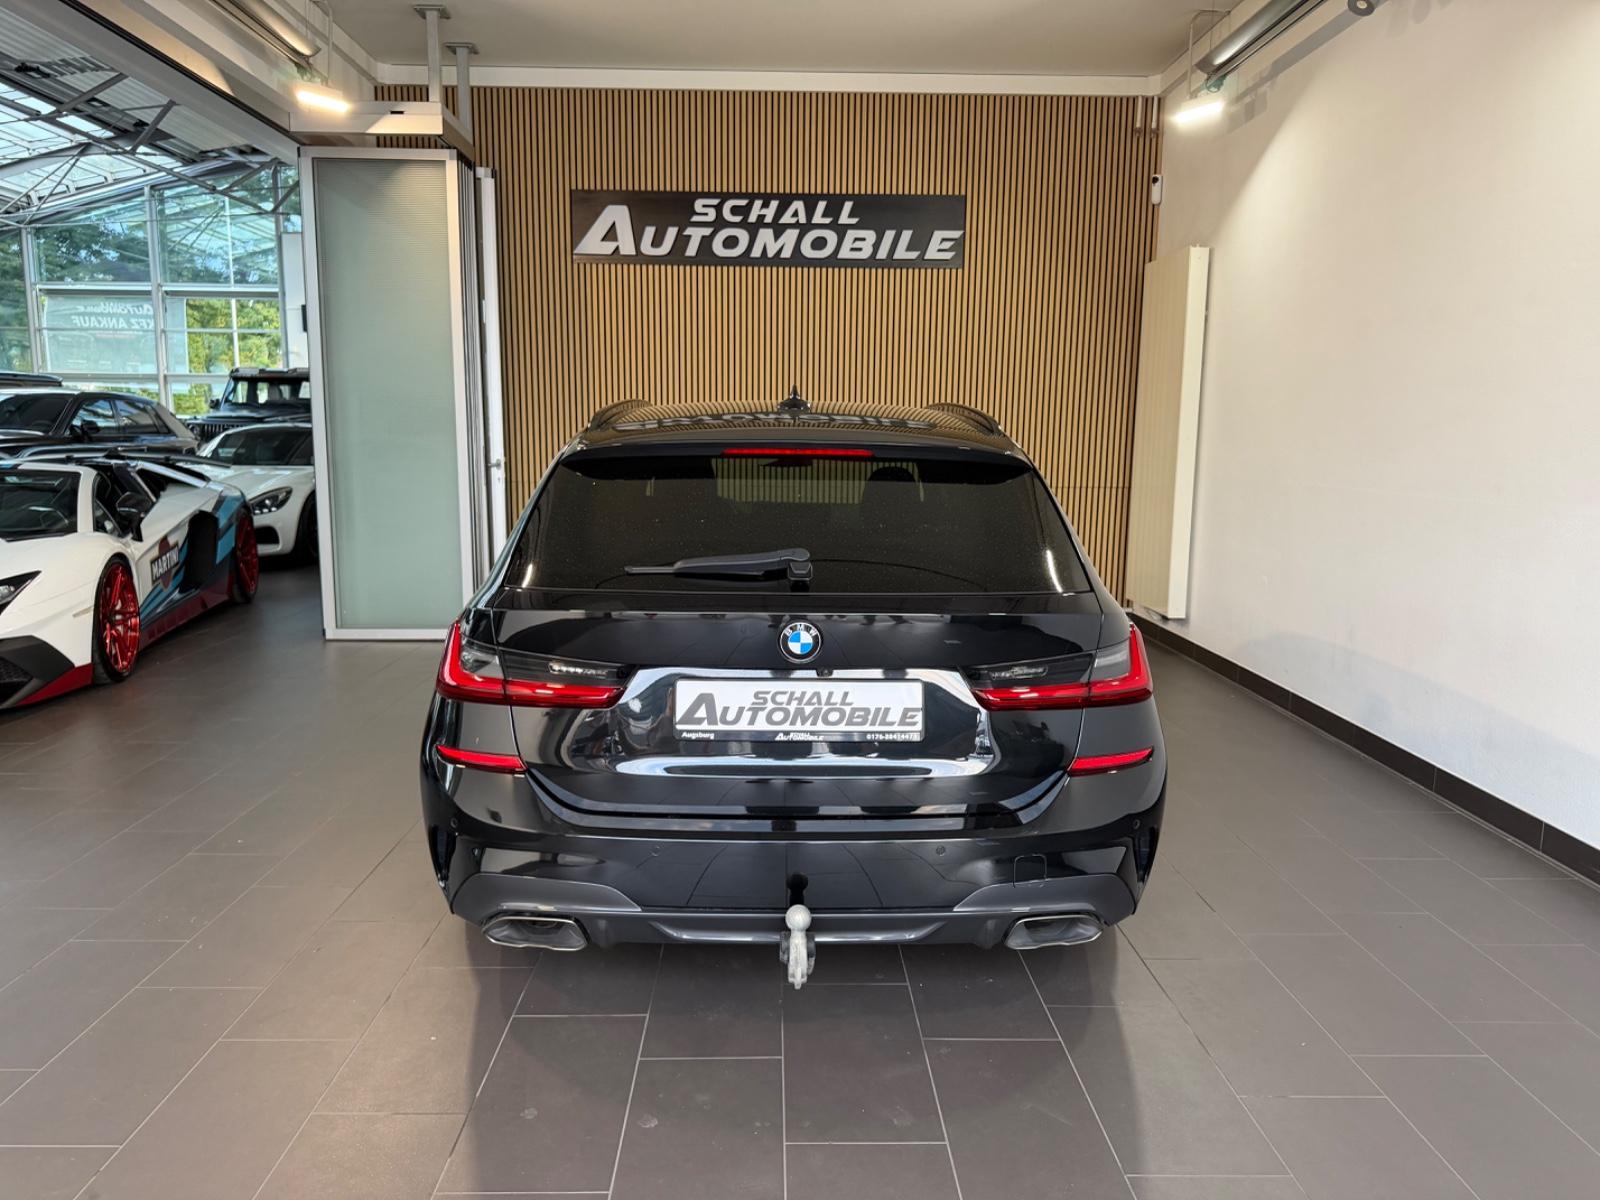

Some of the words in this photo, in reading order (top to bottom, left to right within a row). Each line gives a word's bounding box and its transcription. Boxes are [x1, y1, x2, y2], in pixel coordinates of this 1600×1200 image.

[690, 198, 860, 224] SCHALL
[573, 204, 964, 261] AUTOMOBILE
[151, 545, 179, 581] MARTINI
[783, 623, 818, 637] BMW
[677, 693, 922, 726] AUTOMOBILE
[751, 690, 854, 706] SCHALL
[681, 731, 715, 740] Augsburg
